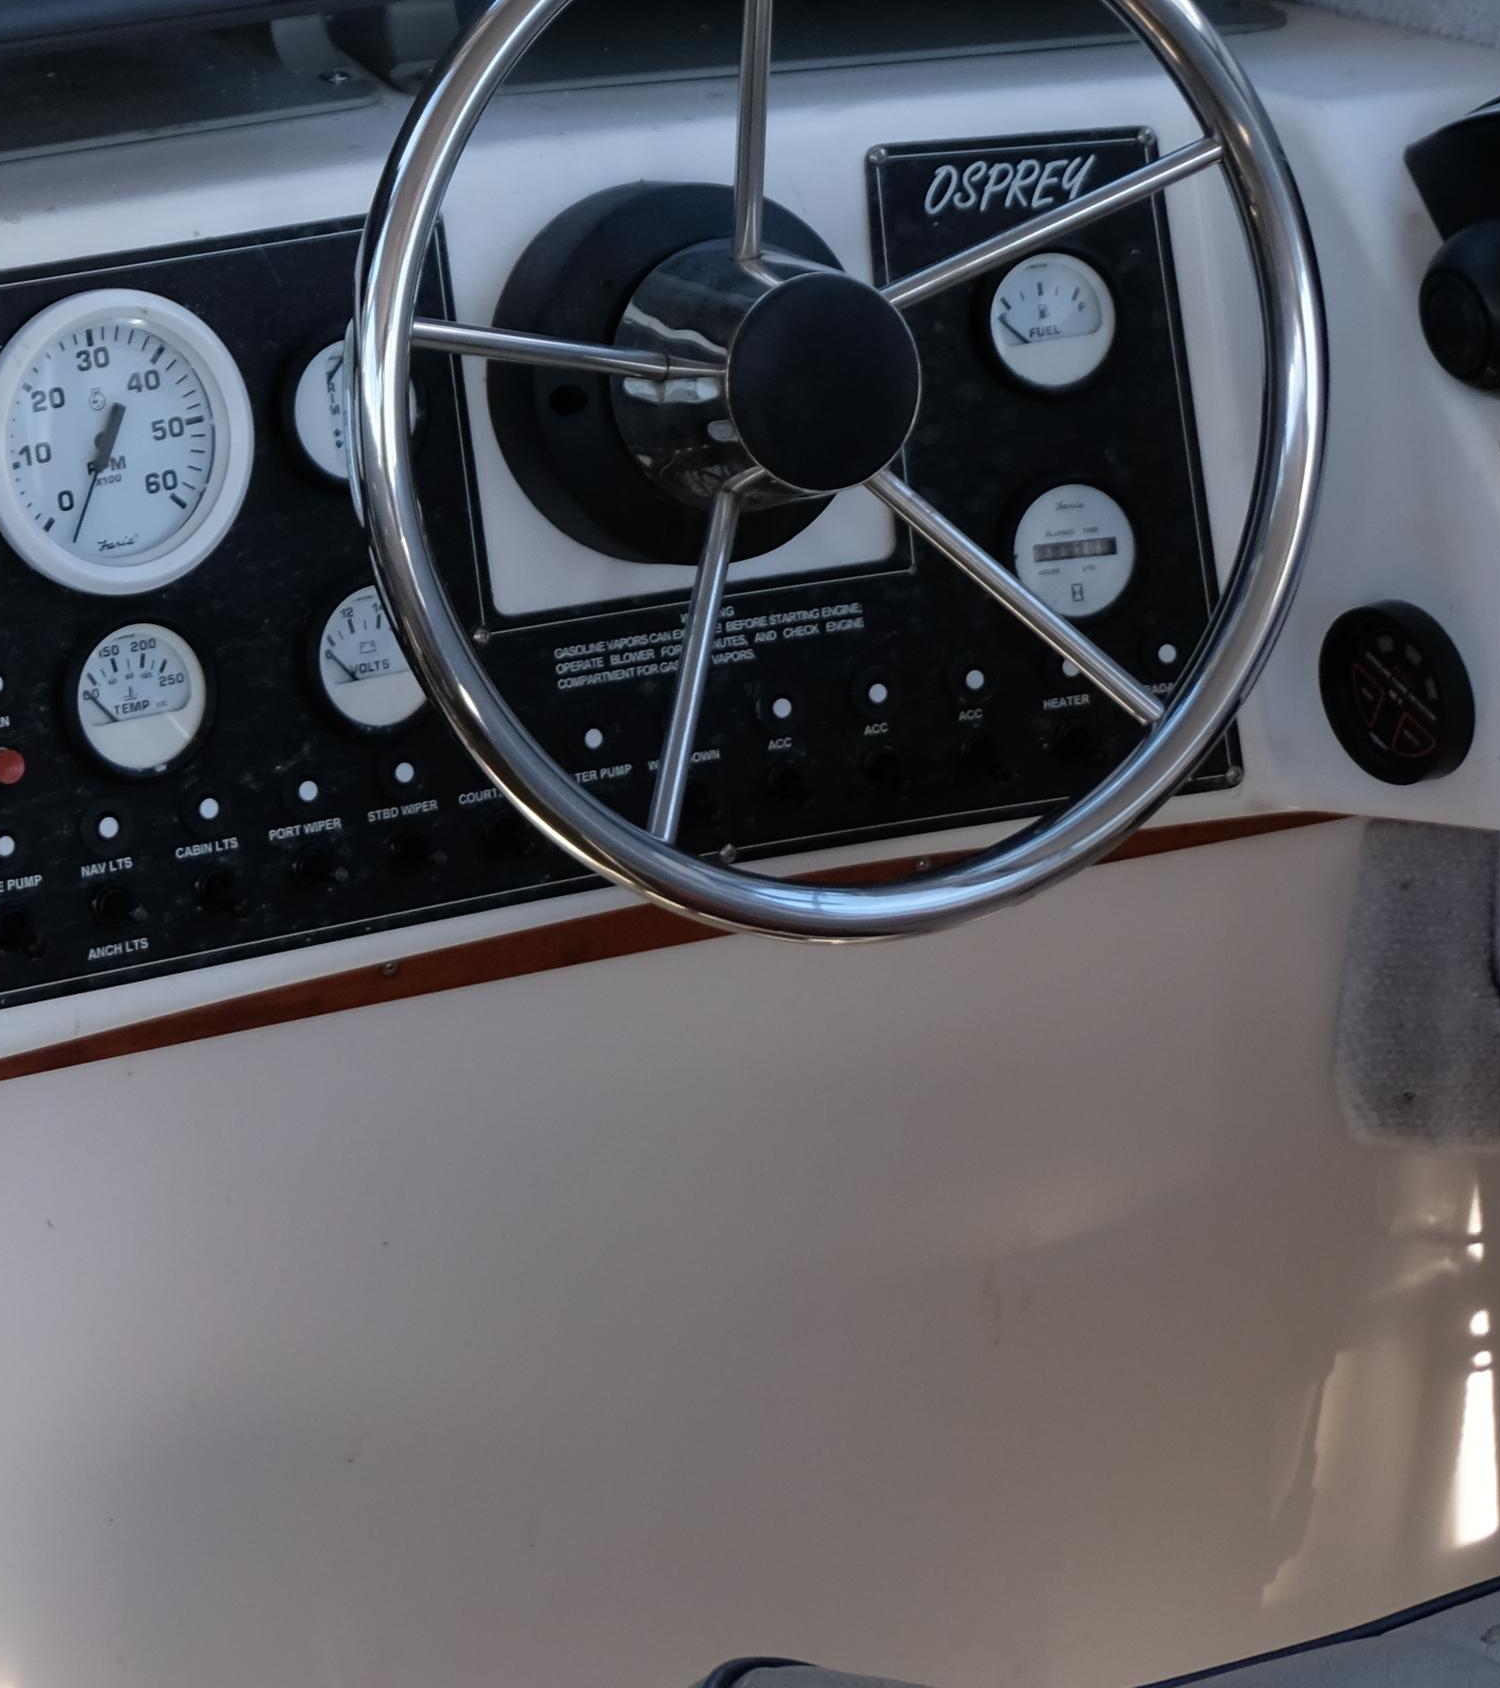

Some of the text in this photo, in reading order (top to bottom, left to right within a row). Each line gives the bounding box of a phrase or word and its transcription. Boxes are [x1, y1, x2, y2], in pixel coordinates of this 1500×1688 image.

[924, 153, 1096, 215] OSPREY
[1029, 326, 1061, 338] FUEL
[76, 346, 110, 372] 30
[127, 369, 160, 393] 40
[30, 387, 65, 412] 20
[151, 416, 185, 441] 50
[18, 442, 52, 466] 10
[145, 469, 178, 494] 60
[57, 489, 75, 512] 0
[341, 607, 354, 618] 12
[554, 642, 605, 659] GASOLINE
[607, 634, 648, 650] VAPORS
[649, 629, 671, 643] CAN
[726, 616, 767, 632] BEFORE
[769, 608, 820, 625] STARTING
[99, 645, 120, 658] 150
[130, 638, 157, 652] 200
[555, 617, 864, 674] OPERATE BLOWER FOR AND CHECK ENGINE
[350, 658, 390, 673] VOLTS
[159, 673, 184, 687] 250
[557, 667, 634, 690] COMPARTMENT
[637, 665, 658, 677] FOR
[114, 700, 150, 715] TEMP
[1043, 694, 1090, 710] HEATER
[959, 708, 983, 722] ACC
[864, 722, 888, 736] ACC
[768, 737, 792, 751] ACC
[600, 764, 632, 779] PUMP
[367, 799, 438, 823] STBD WIPER
[268, 818, 342, 841] PORT WIPER
[175, 837, 239, 859] CABIN LTS
[81, 857, 133, 878] NAV LTS
[7, 874, 43, 891] PUMP
[88, 937, 149, 960] ANCH LTS
